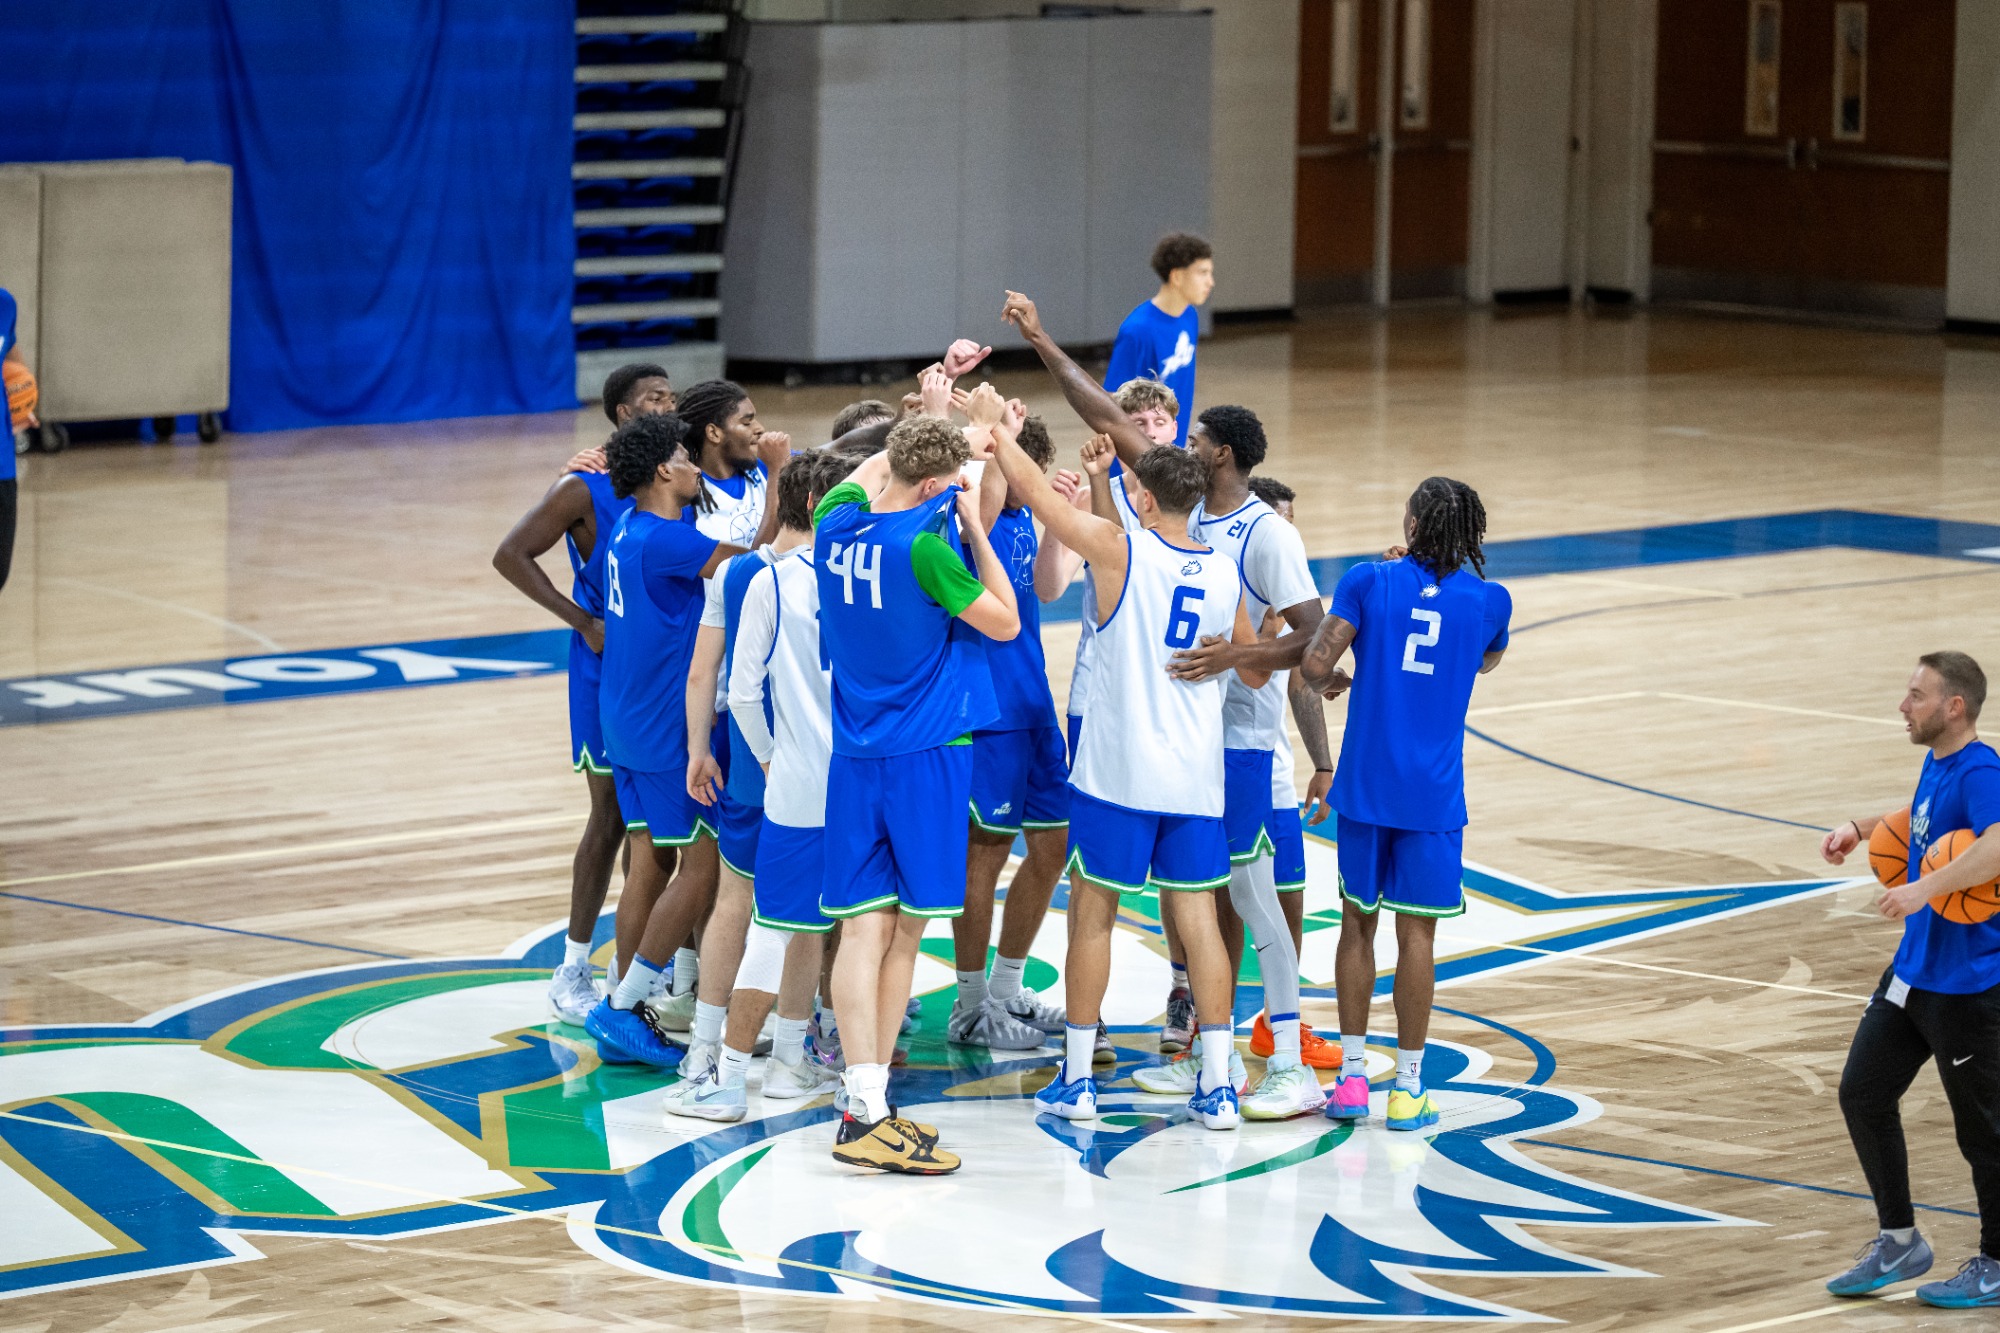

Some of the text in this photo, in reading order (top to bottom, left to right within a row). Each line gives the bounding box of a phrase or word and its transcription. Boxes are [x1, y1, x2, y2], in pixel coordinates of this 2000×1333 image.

[1226, 520, 1248, 539] 21
[607, 549, 625, 619] 13
[825, 541, 883, 610] 44
[1163, 585, 1206, 650] 6
[1401, 607, 1442, 677] 2
[9, 646, 556, 709] Your
